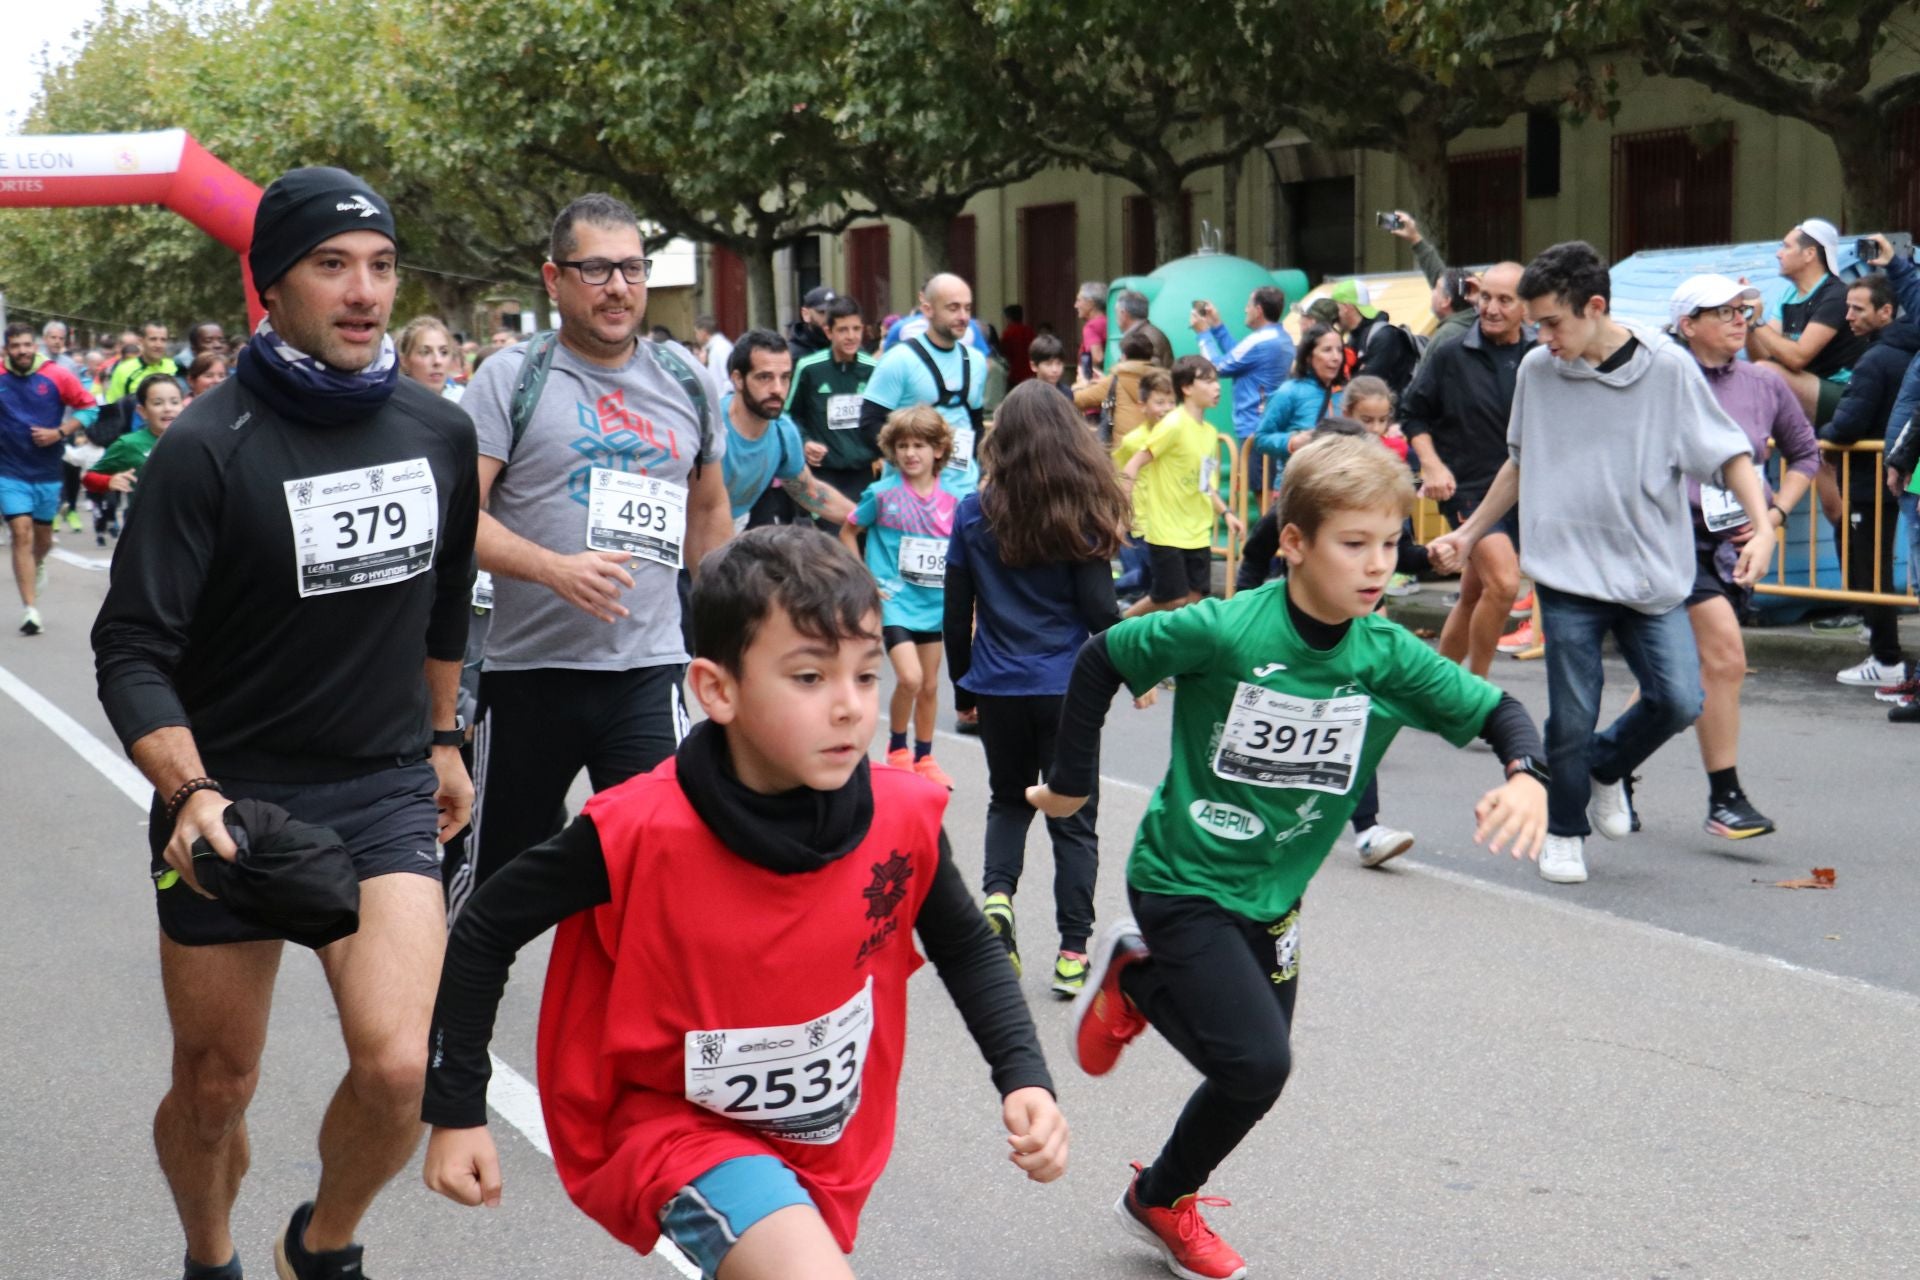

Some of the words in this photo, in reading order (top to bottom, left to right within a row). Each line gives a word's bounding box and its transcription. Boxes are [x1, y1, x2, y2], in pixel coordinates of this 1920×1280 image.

[16, 150, 74, 169] LEÓN
[333, 502, 407, 549] 379
[617, 500, 667, 532] 493
[368, 565, 408, 581] HYUNDAI
[1245, 720, 1342, 756] 3915
[1198, 804, 1255, 836] ABRIL
[738, 1037, 794, 1053] emico
[724, 1041, 857, 1113] 2533
